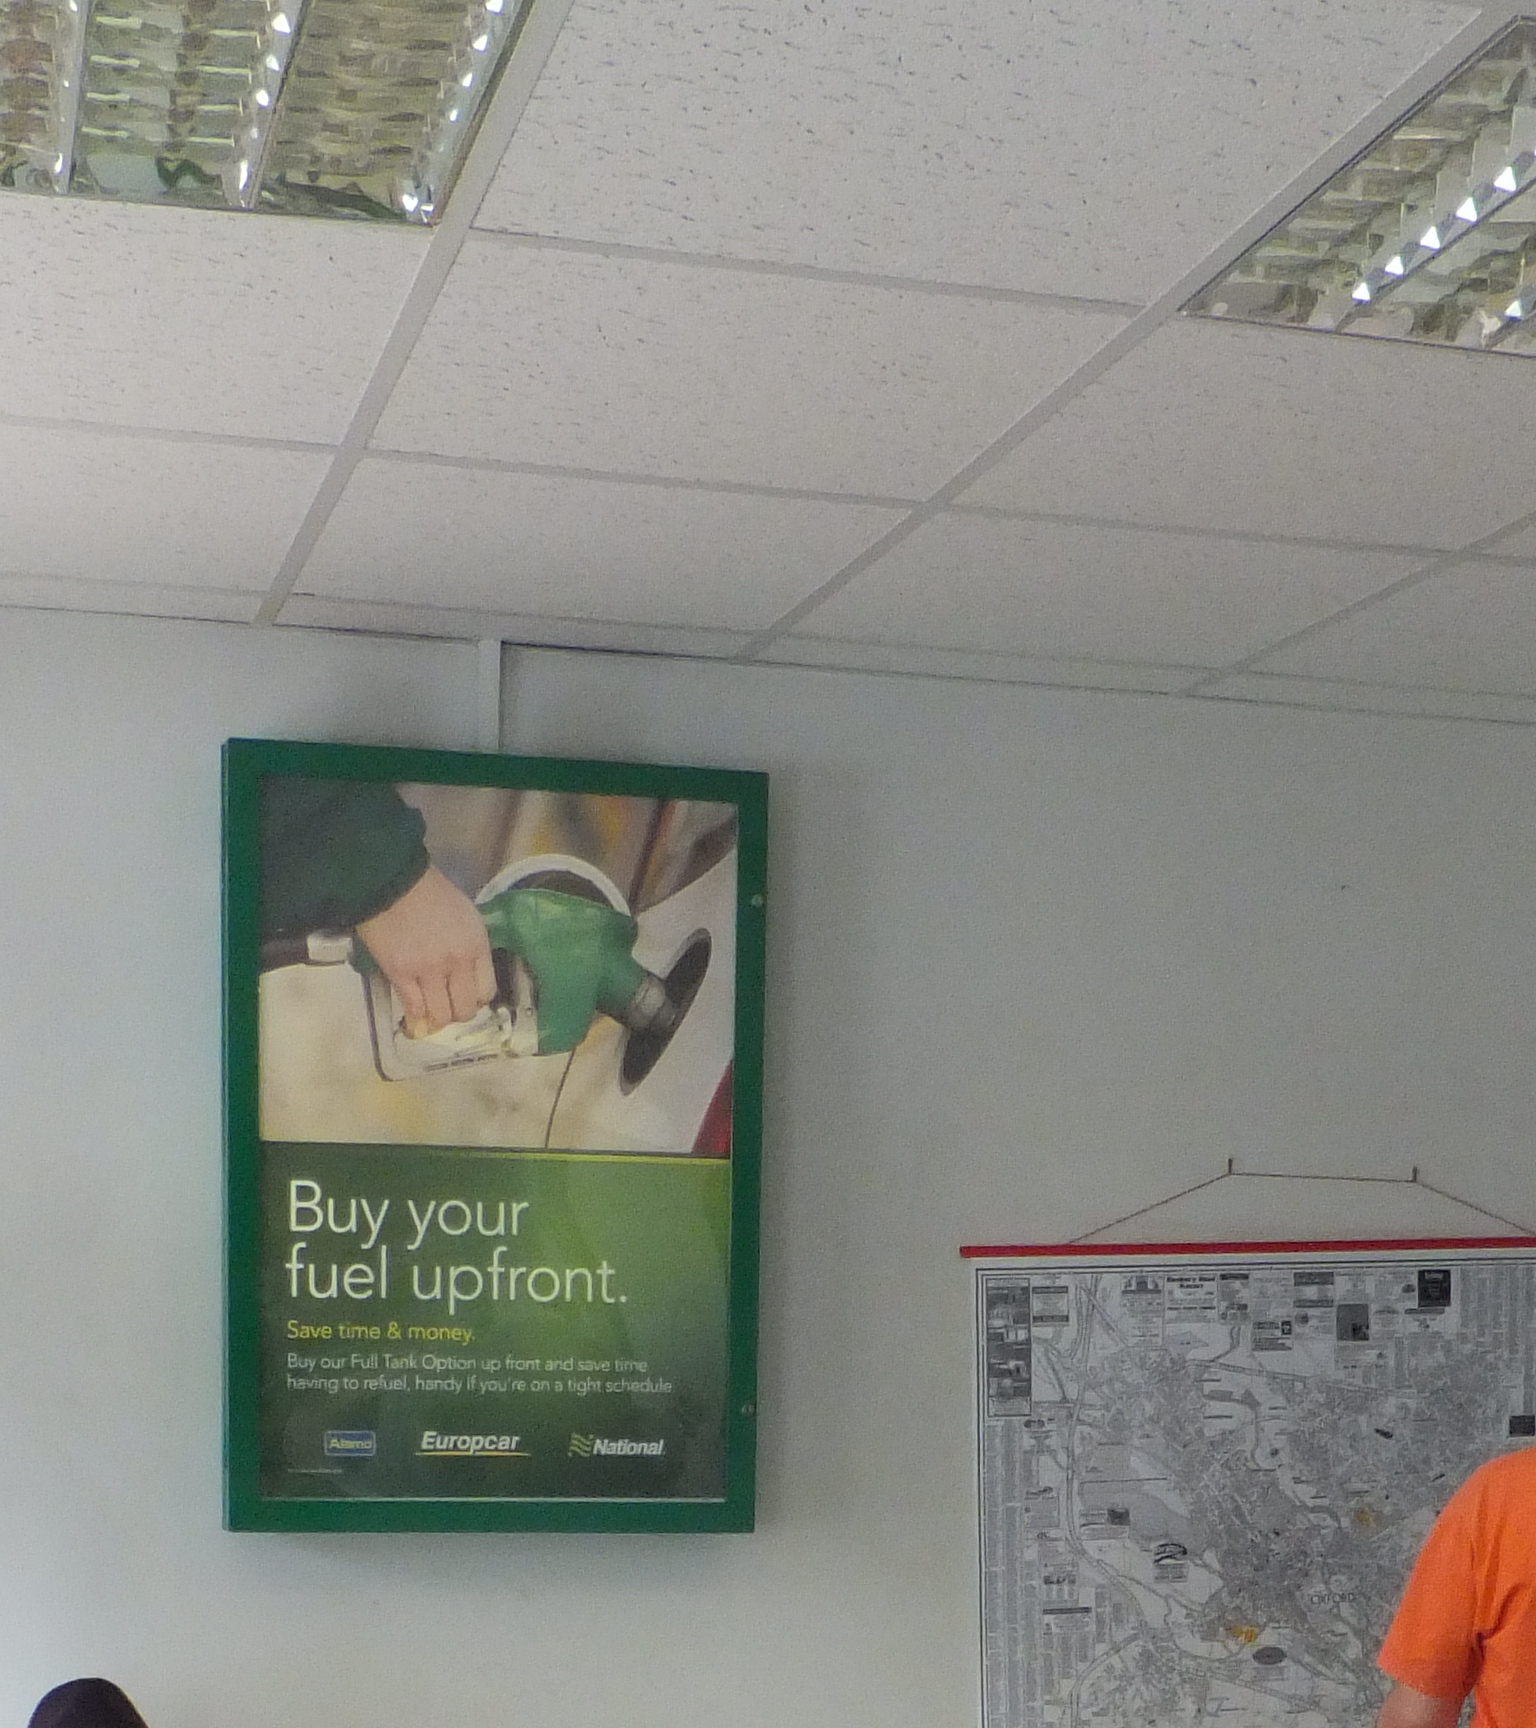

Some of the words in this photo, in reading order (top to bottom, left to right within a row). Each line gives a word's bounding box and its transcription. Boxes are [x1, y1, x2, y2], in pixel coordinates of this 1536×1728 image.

[288, 1179, 390, 1250] Buy
[406, 1199, 530, 1251] your
[284, 1242, 388, 1299] fuel
[412, 1245, 628, 1316] upfront.
[286, 1319, 333, 1340] Save
[338, 1322, 381, 1340] time
[386, 1320, 402, 1340] &
[407, 1325, 476, 1346] money.
[287, 1352, 316, 1373] Buy
[319, 1356, 347, 1370] our
[350, 1353, 379, 1370] Full
[382, 1353, 417, 1370] Tank
[421, 1353, 477, 1373] Option
[481, 1357, 502, 1373] up
[505, 1354, 541, 1371] front
[544, 1356, 574, 1372] and
[577, 1359, 611, 1372] save
[614, 1357, 649, 1373] time
[286, 1373, 339, 1394] having
[342, 1376, 360, 1391] to
[363, 1374, 411, 1393] refuel,
[415, 1374, 463, 1394] handy
[480, 1377, 527, 1395] you're
[530, 1379, 550, 1392] on
[554, 1380, 564, 1392] a
[567, 1375, 603, 1396] tight
[605, 1376, 674, 1393] schedule
[420, 1430, 521, 1454] Europcar
[593, 1437, 665, 1456] National
